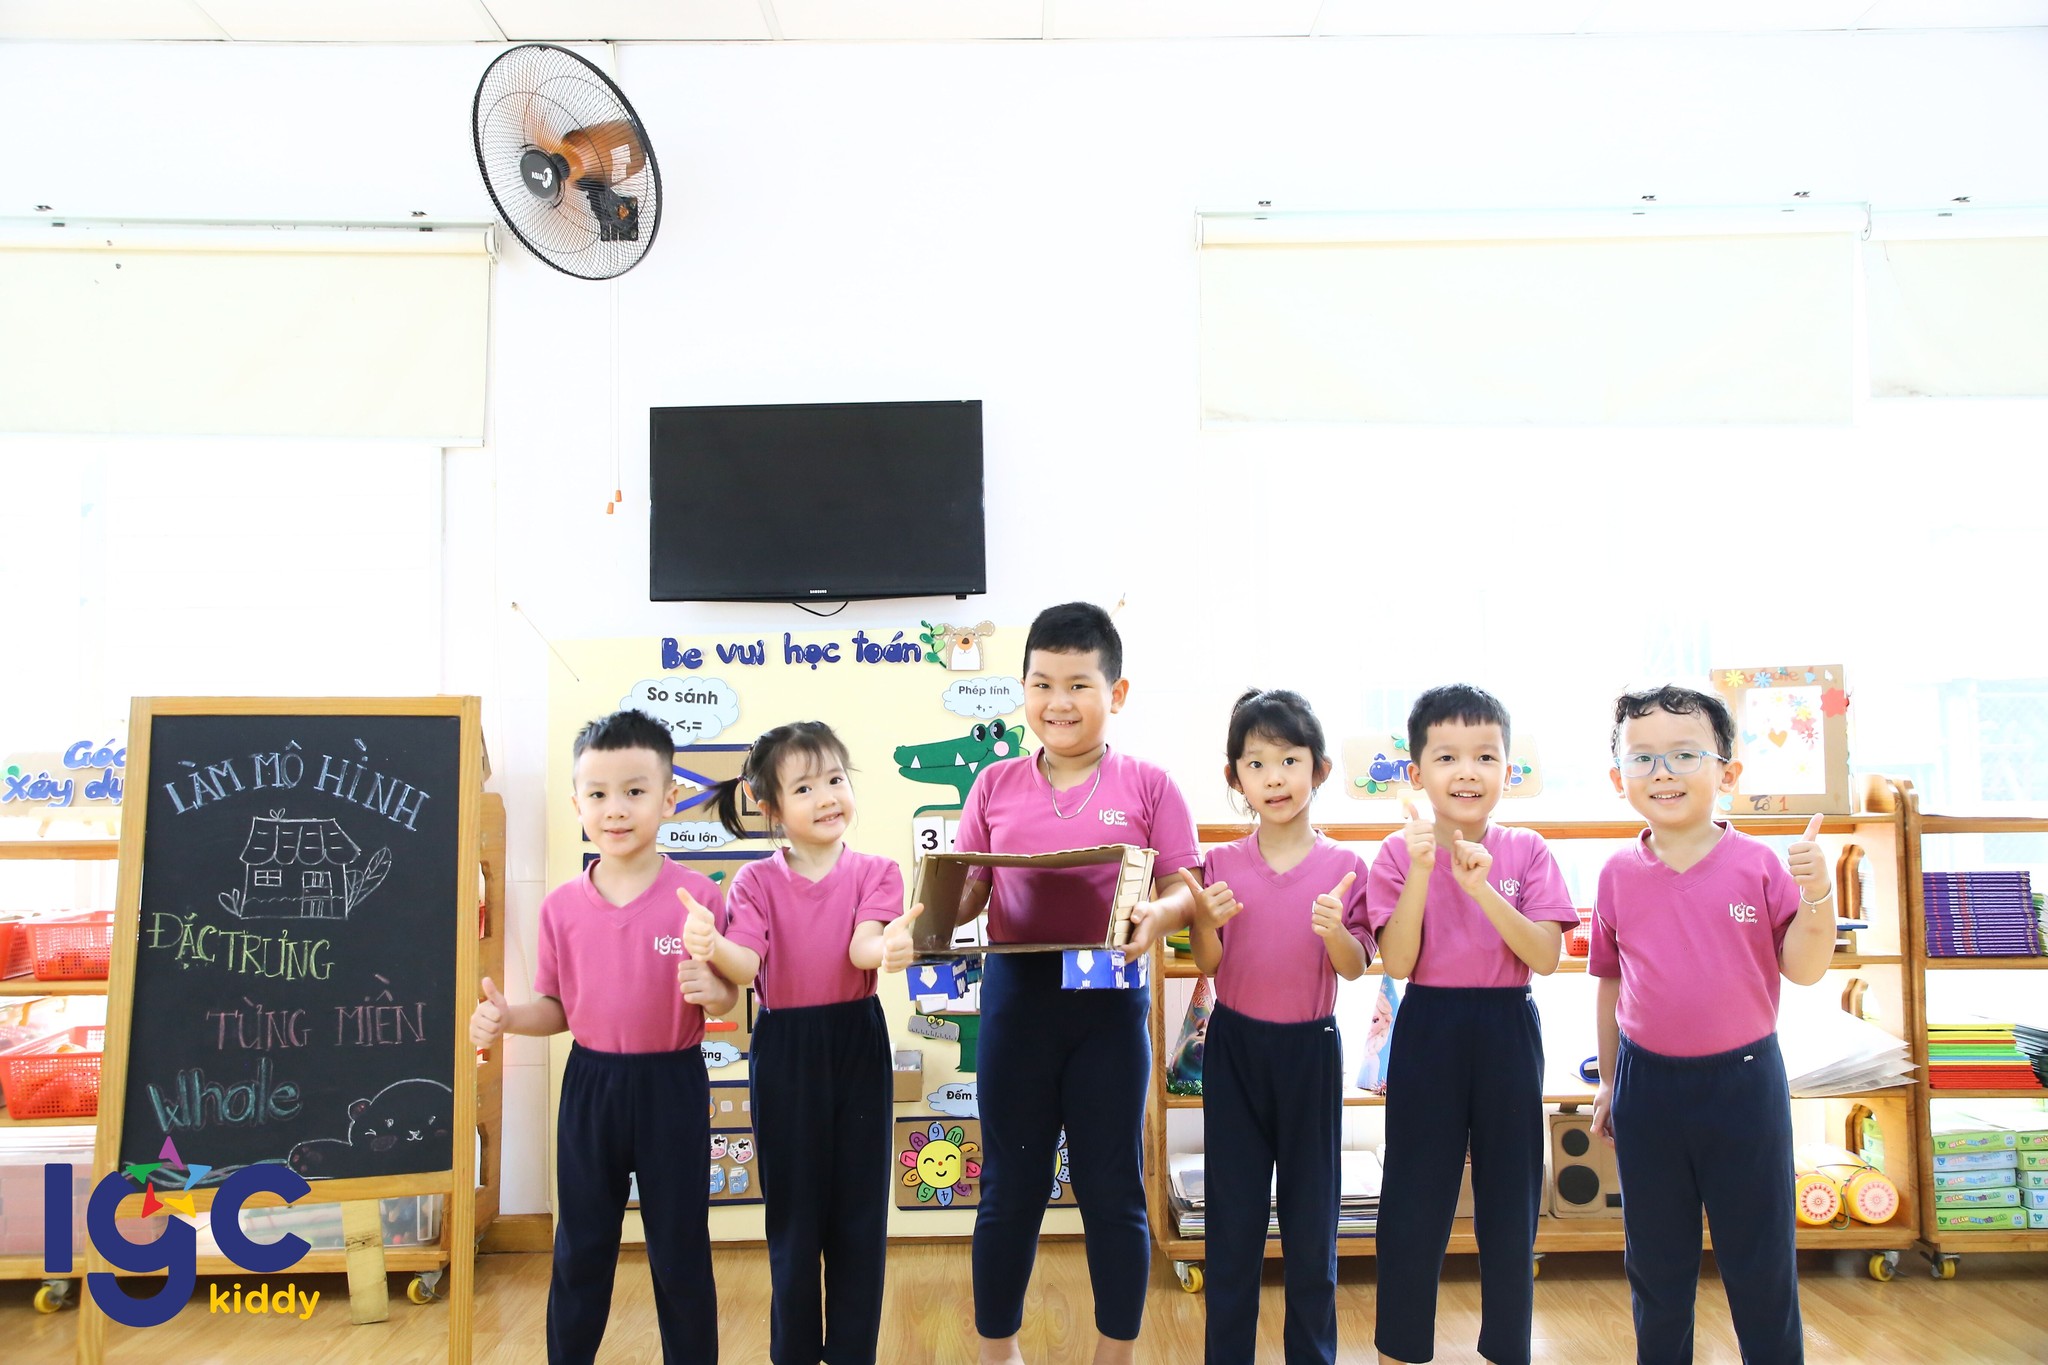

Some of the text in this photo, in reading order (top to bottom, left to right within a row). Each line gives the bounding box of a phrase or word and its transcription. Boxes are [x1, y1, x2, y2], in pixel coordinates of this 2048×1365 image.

[716, 639, 765, 665] vui
[784, 632, 841, 670] học
[852, 630, 922, 663] toán
[647, 687, 718, 705] So sánh
[958, 685, 1010, 696] Phép tính
[63, 738, 126, 769] Góc
[163, 738, 431, 832] LÀM MÔ HÌNH
[670, 830, 718, 842] Dấu lớn
[921, 829, 939, 850] 3
[146, 911, 335, 981] ĐẶC TRƯNG
[206, 973, 427, 1051] TỪNG MIỀN
[946, 1088, 972, 1100] Đếm
[932, 1126, 939, 1138] 9
[949, 1130, 962, 1143] 10
[914, 1136, 924, 1147] 8
[904, 1154, 915, 1163] 7
[966, 1164, 977, 1174] 2
[922, 1186, 931, 1198] 5
[940, 1190, 949, 1201] 4
